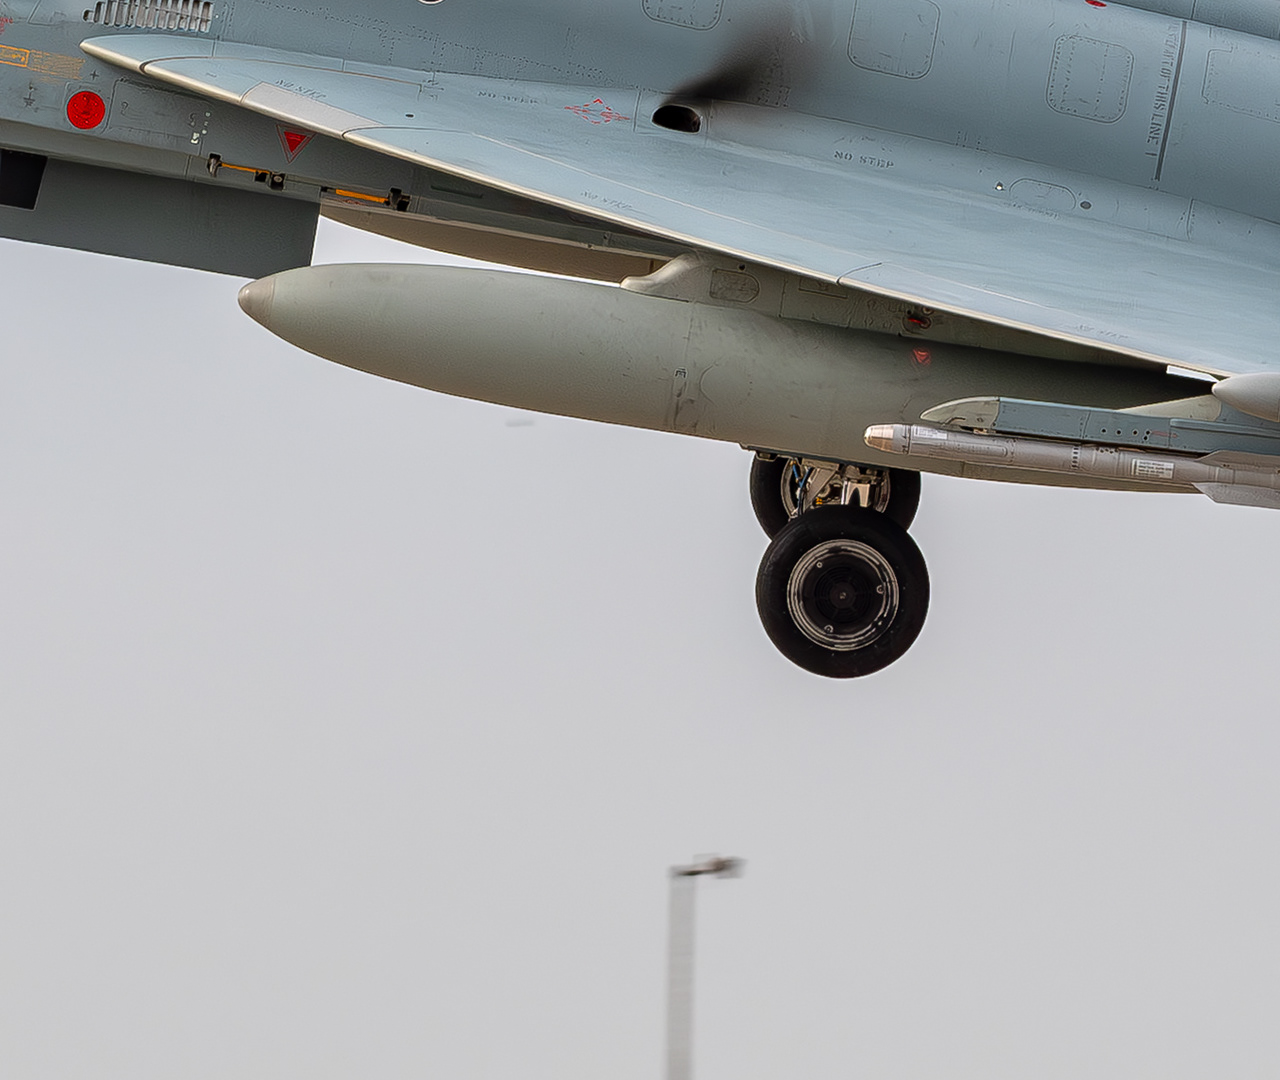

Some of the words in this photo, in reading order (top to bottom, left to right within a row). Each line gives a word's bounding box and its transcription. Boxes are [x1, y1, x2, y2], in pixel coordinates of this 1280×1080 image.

[1147, 113, 1164, 145] LINE
[833, 150, 854, 162] NO
[858, 155, 895, 170] STEP
